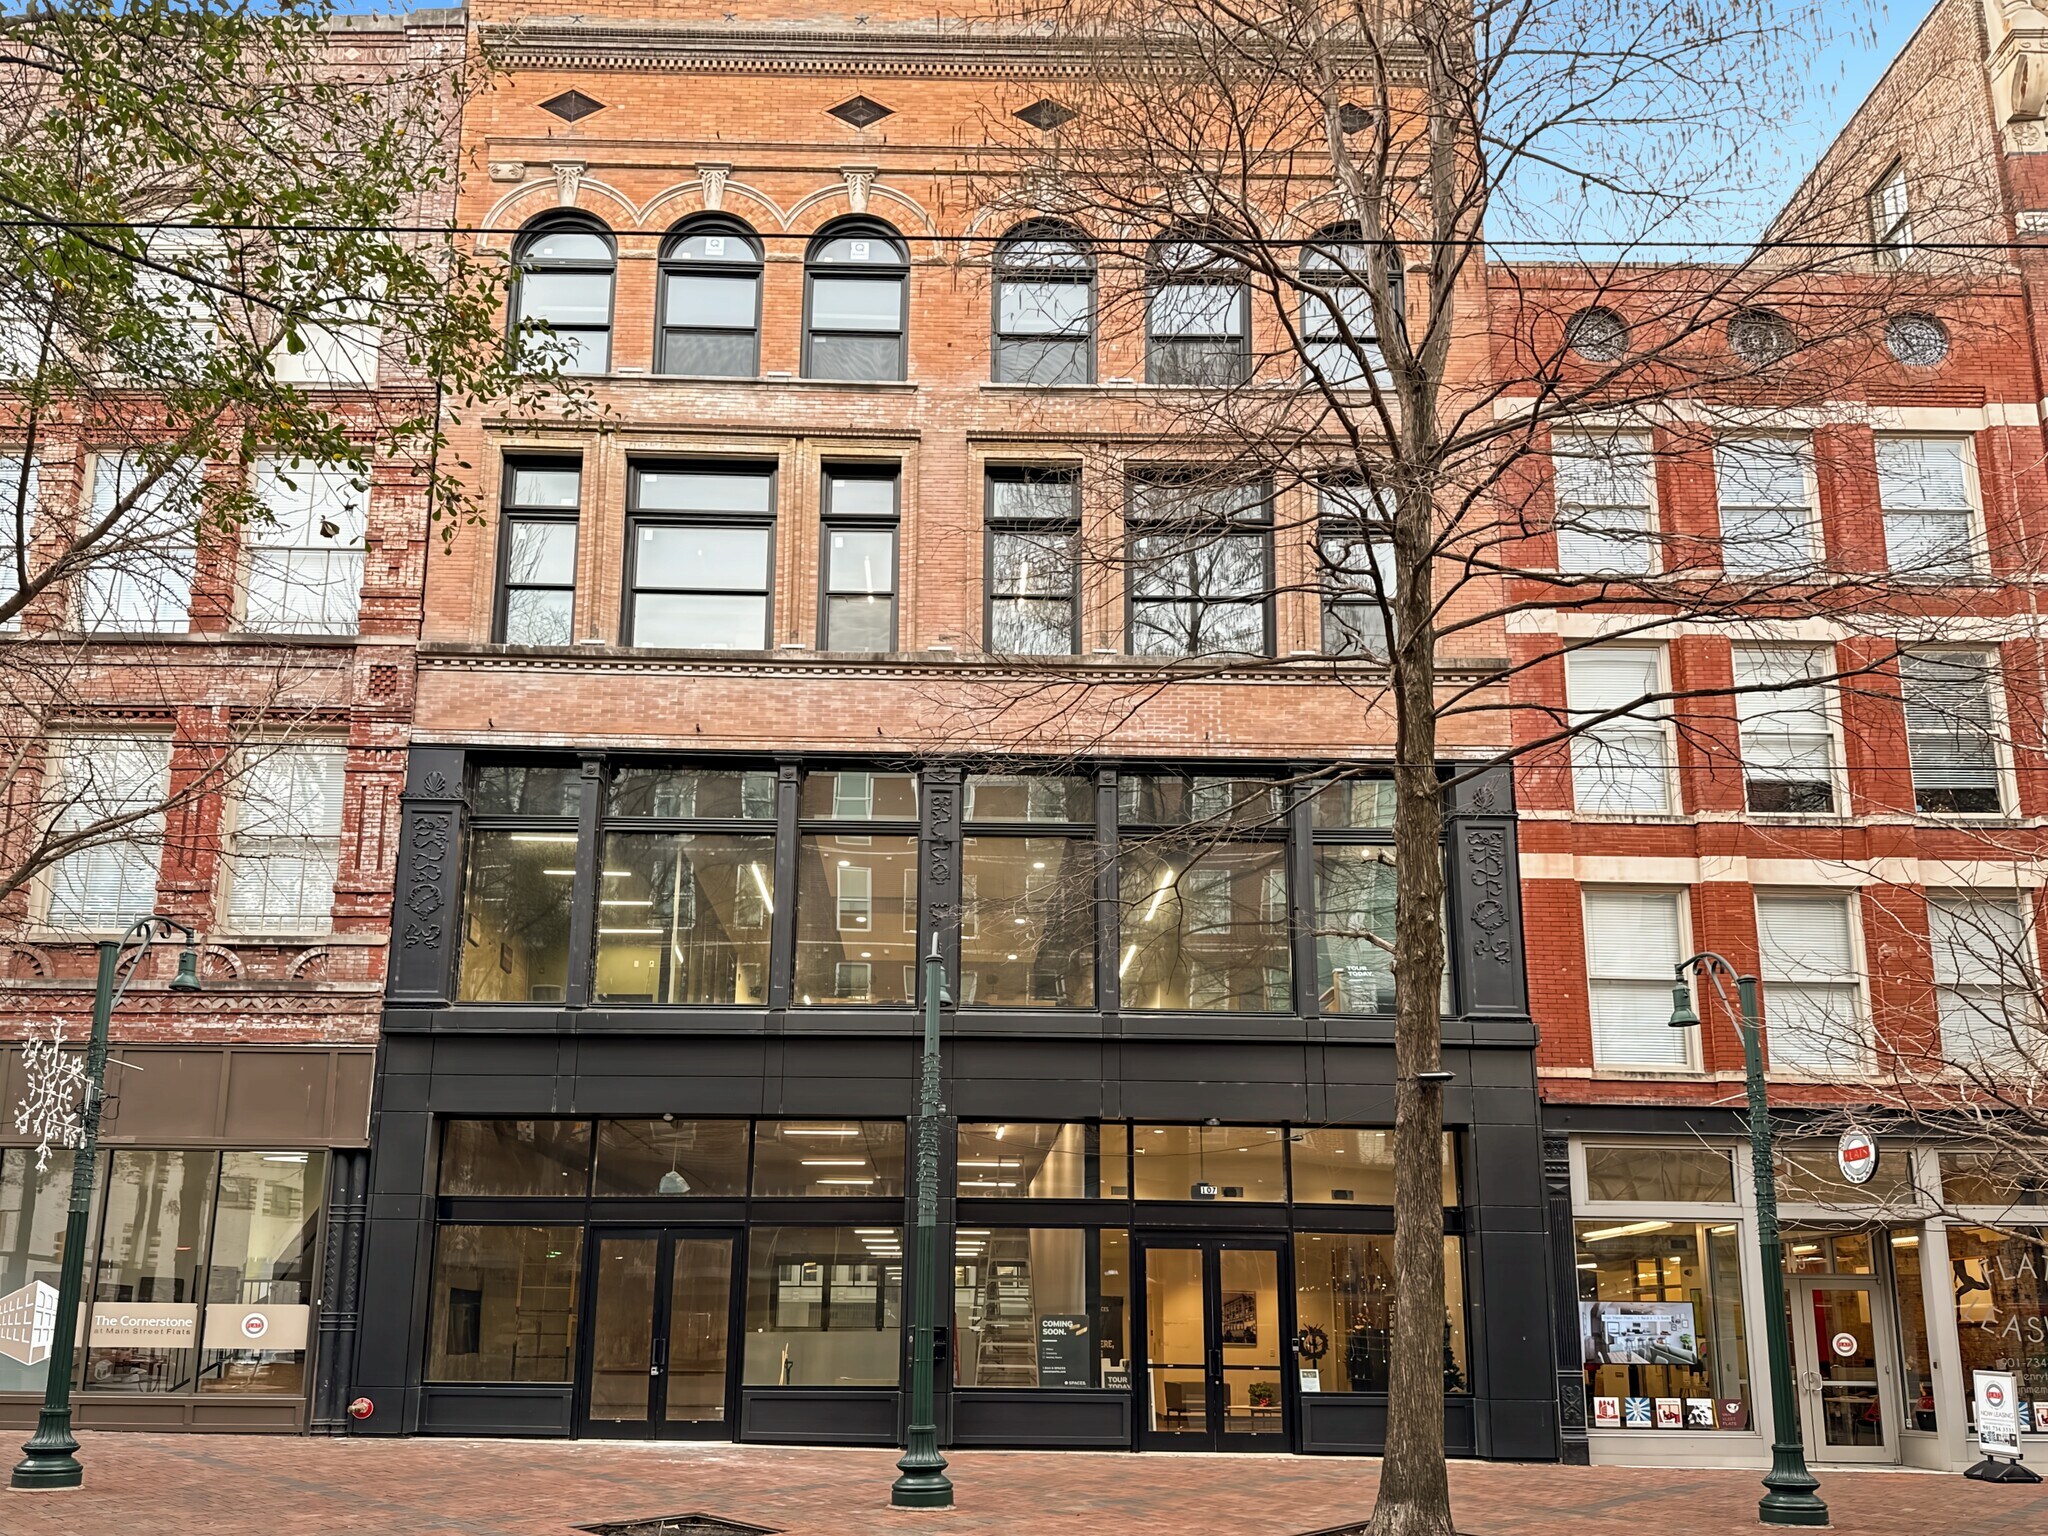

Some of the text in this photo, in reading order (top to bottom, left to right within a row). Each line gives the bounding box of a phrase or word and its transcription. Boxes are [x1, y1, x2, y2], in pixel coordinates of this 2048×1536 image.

[1202, 1186, 1217, 1194] 107
[94, 1315, 193, 1327] The Cornerstone
[1042, 1320, 1073, 1328] COMING
[1963, 1297, 2048, 1343] LEAS
[105, 1327, 130, 1335] Main
[1042, 1328, 1067, 1336] SOON.
[1994, 1411, 2014, 1419] LEASING
